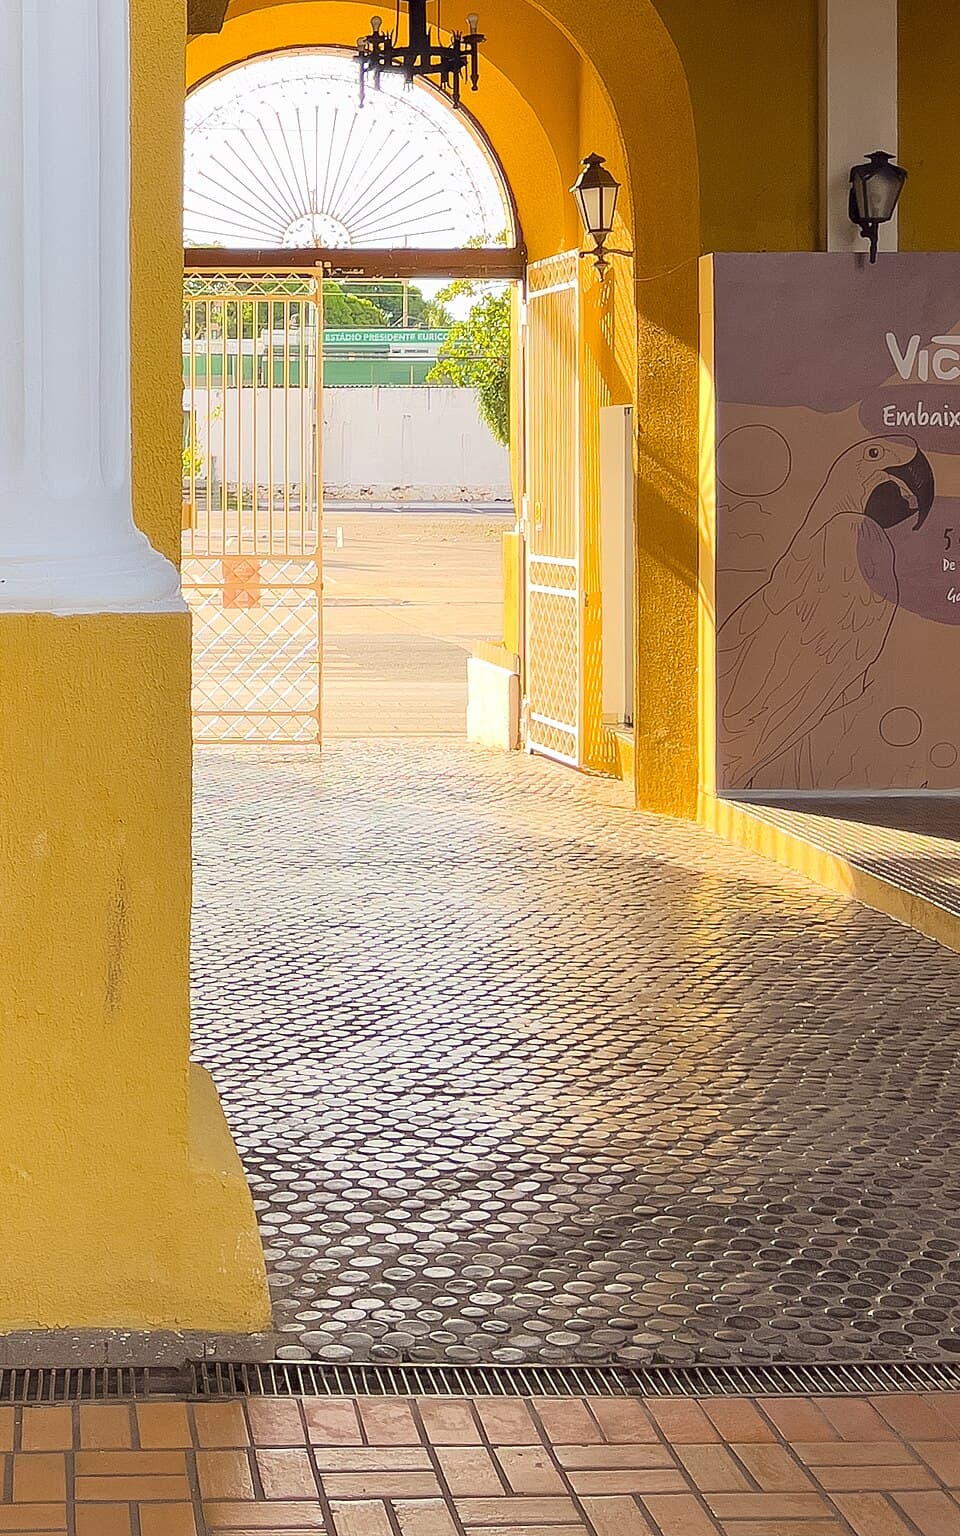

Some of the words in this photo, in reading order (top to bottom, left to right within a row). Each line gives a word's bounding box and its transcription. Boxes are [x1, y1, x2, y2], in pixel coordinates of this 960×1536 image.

[325, 332, 361, 342] ESTÁDIO
[943, 527, 954, 551] 5
[943, 558, 956, 572] De
